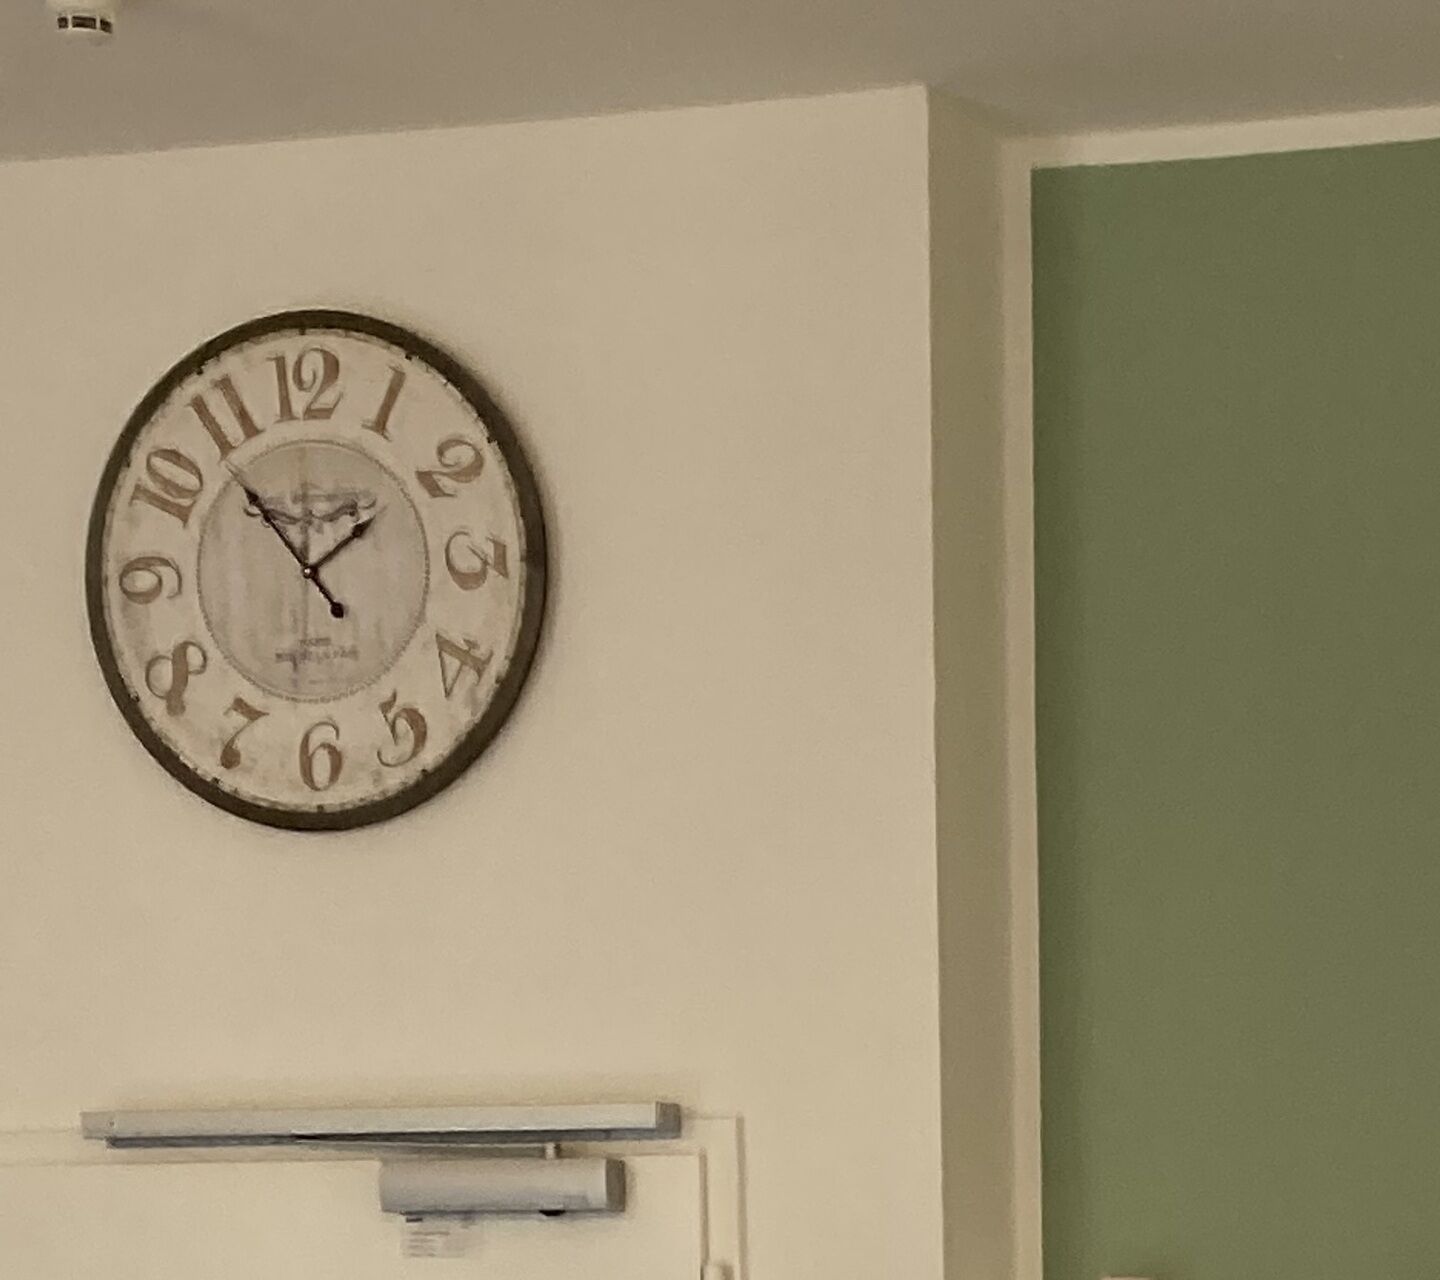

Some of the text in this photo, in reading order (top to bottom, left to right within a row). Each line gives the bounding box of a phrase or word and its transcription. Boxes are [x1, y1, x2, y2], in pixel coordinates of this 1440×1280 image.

[190, 376, 265, 461] 11
[267, 348, 344, 423] 12
[362, 366, 406, 441] 1
[128, 448, 204, 528] 10
[416, 438, 485, 498] 2
[119, 555, 182, 604] 9
[444, 530, 509, 591] 3
[145, 640, 207, 716] 8
[436, 633, 495, 698] 4
[220, 697, 270, 769] 7
[299, 721, 343, 791] 6
[377, 693, 427, 768] 5
